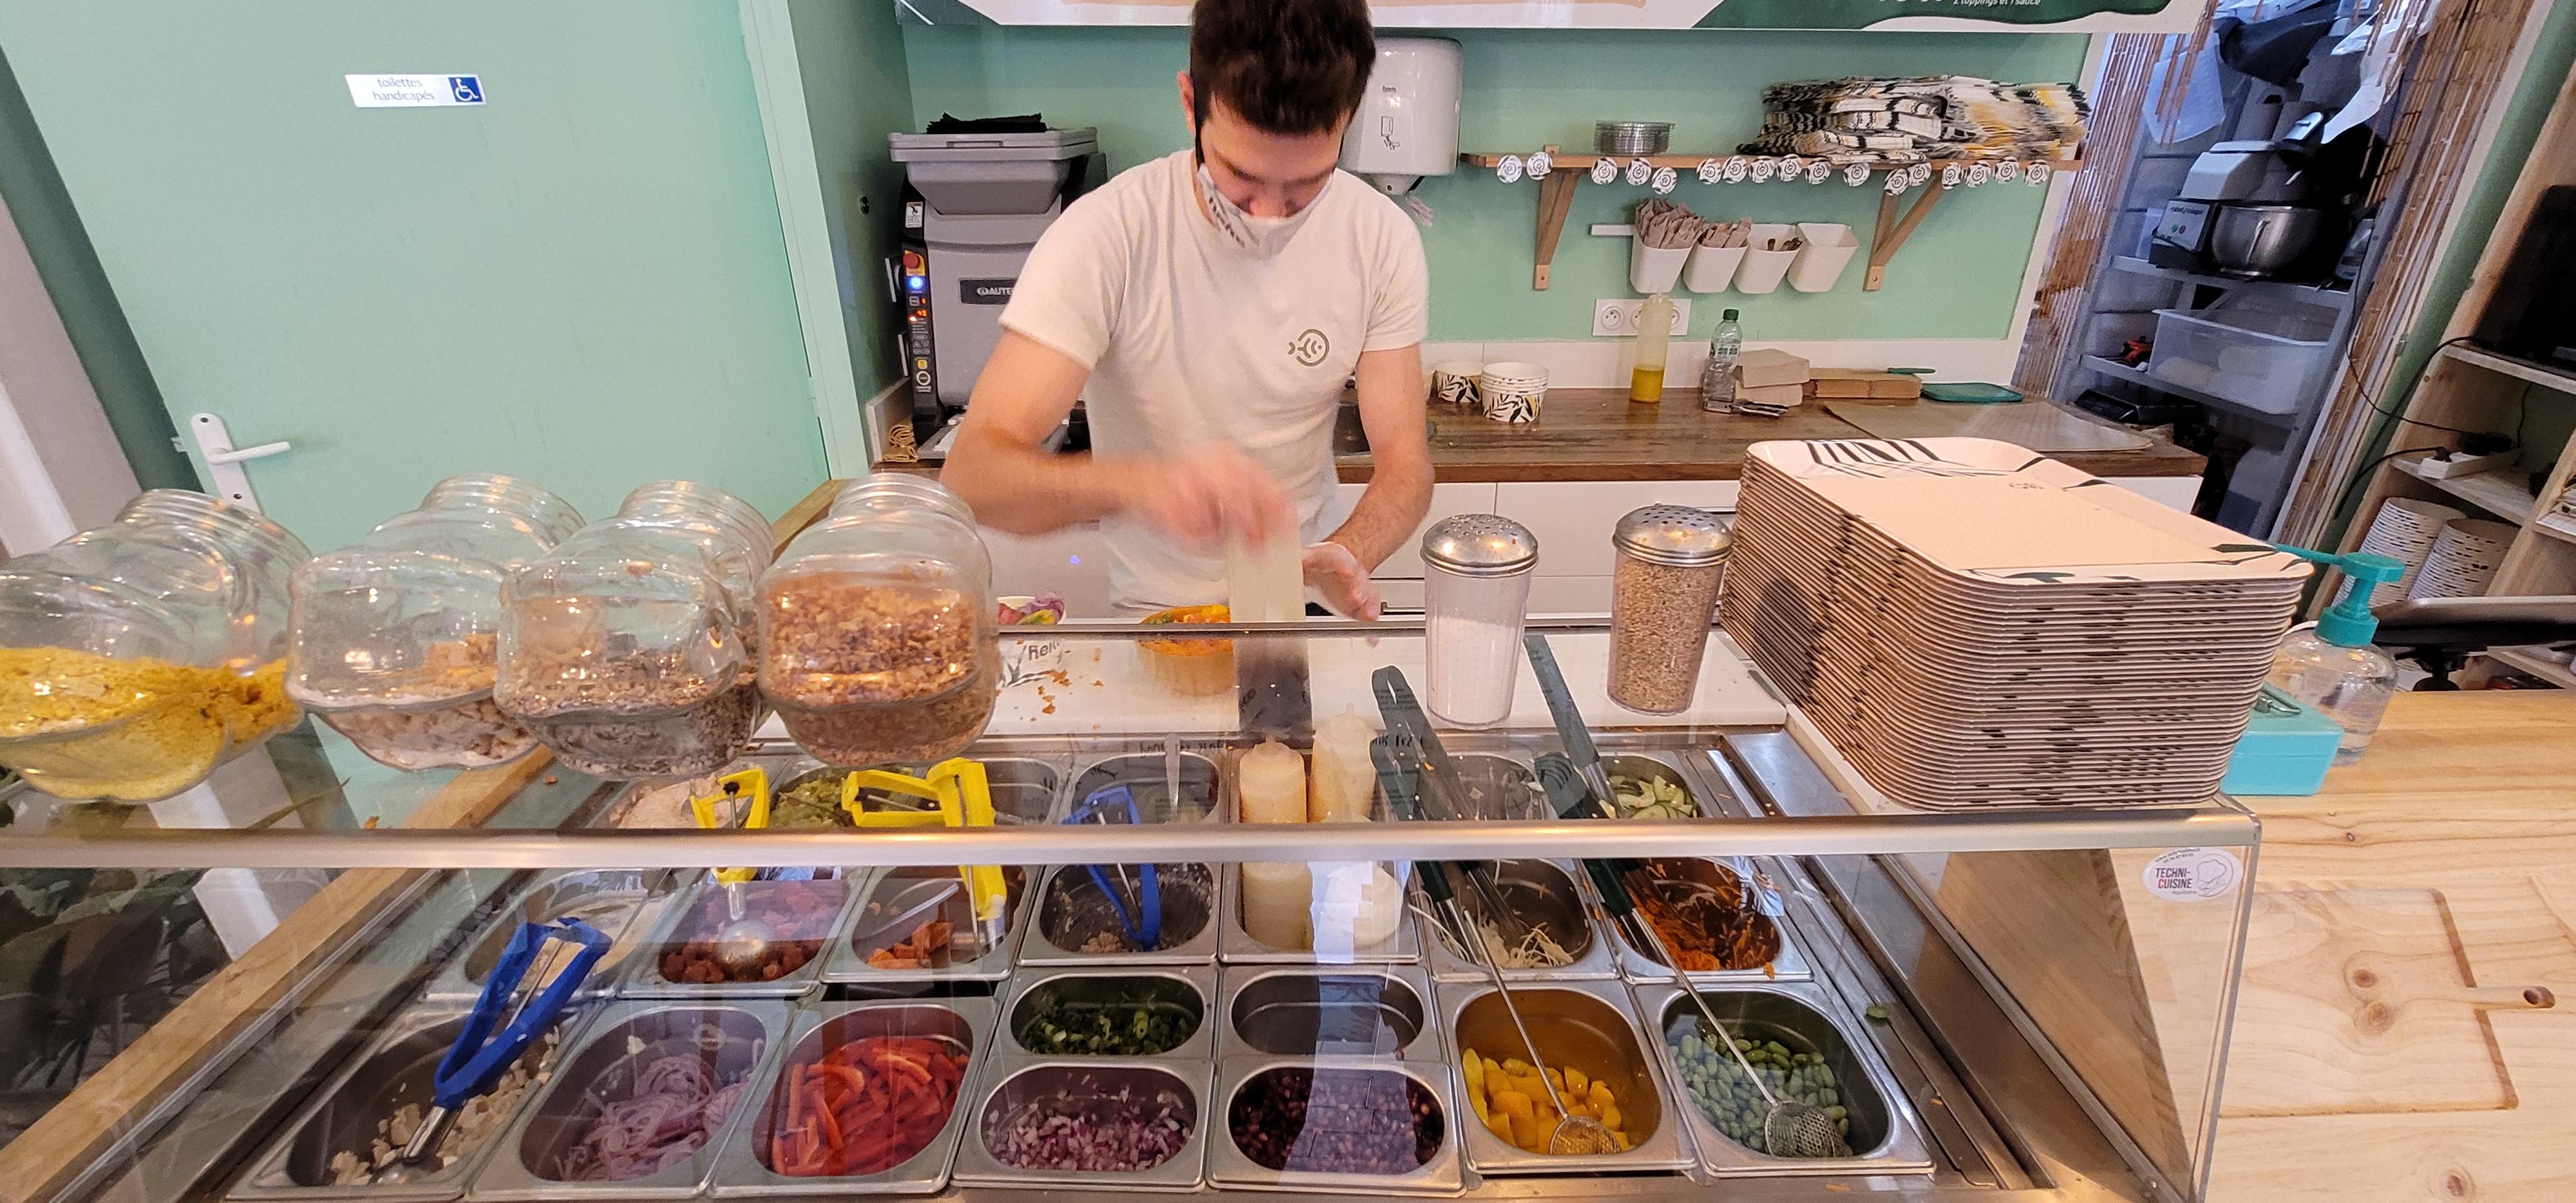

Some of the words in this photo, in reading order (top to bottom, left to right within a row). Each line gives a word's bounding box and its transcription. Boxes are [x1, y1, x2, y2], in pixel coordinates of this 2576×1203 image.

[377, 77, 422, 88] toilettes
[372, 90, 435, 103] handicapés
[2155, 867, 2191, 878] TECHNI-
[2158, 878, 2193, 889] CUISINE
